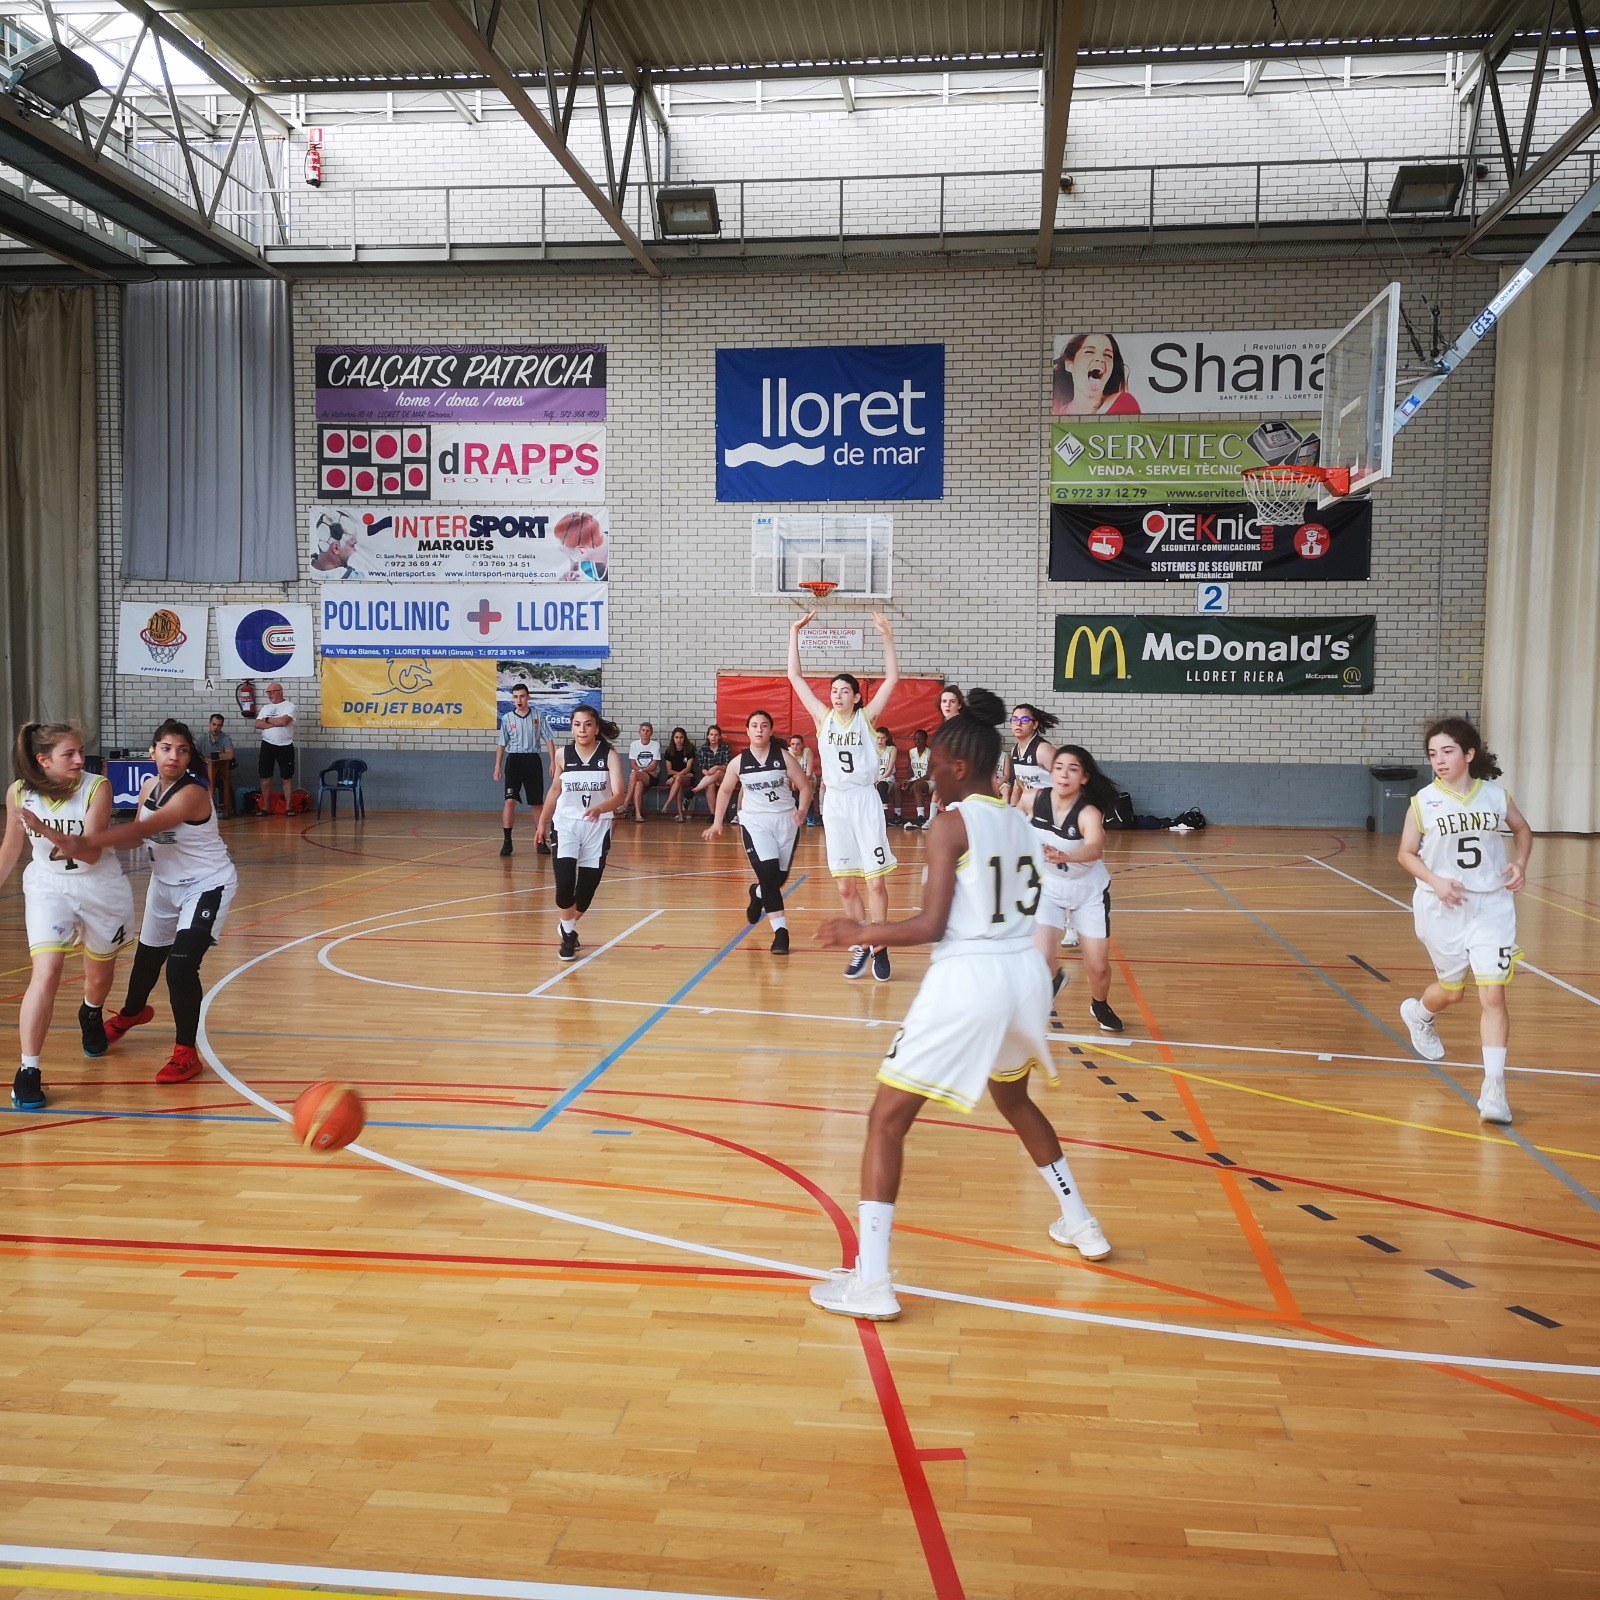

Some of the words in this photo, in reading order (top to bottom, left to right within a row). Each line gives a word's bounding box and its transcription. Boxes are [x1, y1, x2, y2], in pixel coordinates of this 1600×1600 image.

[1471, 310, 1497, 336] GES
[1252, 343, 1297, 351] Revolution
[1302, 342, 1327, 352] shop
[328, 354, 457, 392] CALÇATS
[462, 354, 594, 387] PATRICIA
[396, 391, 430, 407] home
[446, 391, 479, 407] dona
[494, 395, 525, 407] nens
[762, 377, 926, 438] lloret
[833, 441, 865, 466] de
[873, 445, 926, 466] mar
[1087, 432, 1243, 461] SERVITEC
[438, 442, 600, 476] dRAPPS
[1088, 464, 1134, 476] VENDA
[1145, 464, 1191, 476] SERVEI
[1194, 462, 1242, 475] TÈCNIC
[443, 477, 596, 485] BOTIGUES
[1071, 488, 1093, 499] 972
[1097, 488, 1111, 498] 37
[1115, 488, 1129, 498] 12
[1133, 488, 1148, 498] 79
[394, 515, 549, 538] INTERSPORT
[418, 538, 494, 551] MARQUÈS
[1161, 543, 1261, 552] SEGURETAT-COMUNICACIONS
[367, 570, 436, 578] www.intersport.es
[1151, 561, 1197, 572] SISTEMES
[1198, 561, 1210, 572] DE
[1211, 561, 1263, 572] SEGURETAT
[1203, 586, 1223, 610] 2
[324, 600, 450, 631] POLICLINIC
[517, 600, 604, 631] LLORET
[1141, 632, 1351, 662] McDonald's
[205, 679, 214, 690] A
[1186, 670, 1236, 683] LLORET
[1243, 671, 1285, 683] RIERA
[343, 701, 379, 714] DOFI
[381, 702, 408, 716] JET
[411, 702, 463, 715] BOATS
[545, 714, 571, 724] Costa
[839, 751, 855, 774] 9
[873, 846, 886, 865] 9
[1457, 836, 1482, 870] 5
[989, 855, 1042, 924] 13
[111, 924, 125, 946] 4
[1497, 946, 1513, 971] 5
